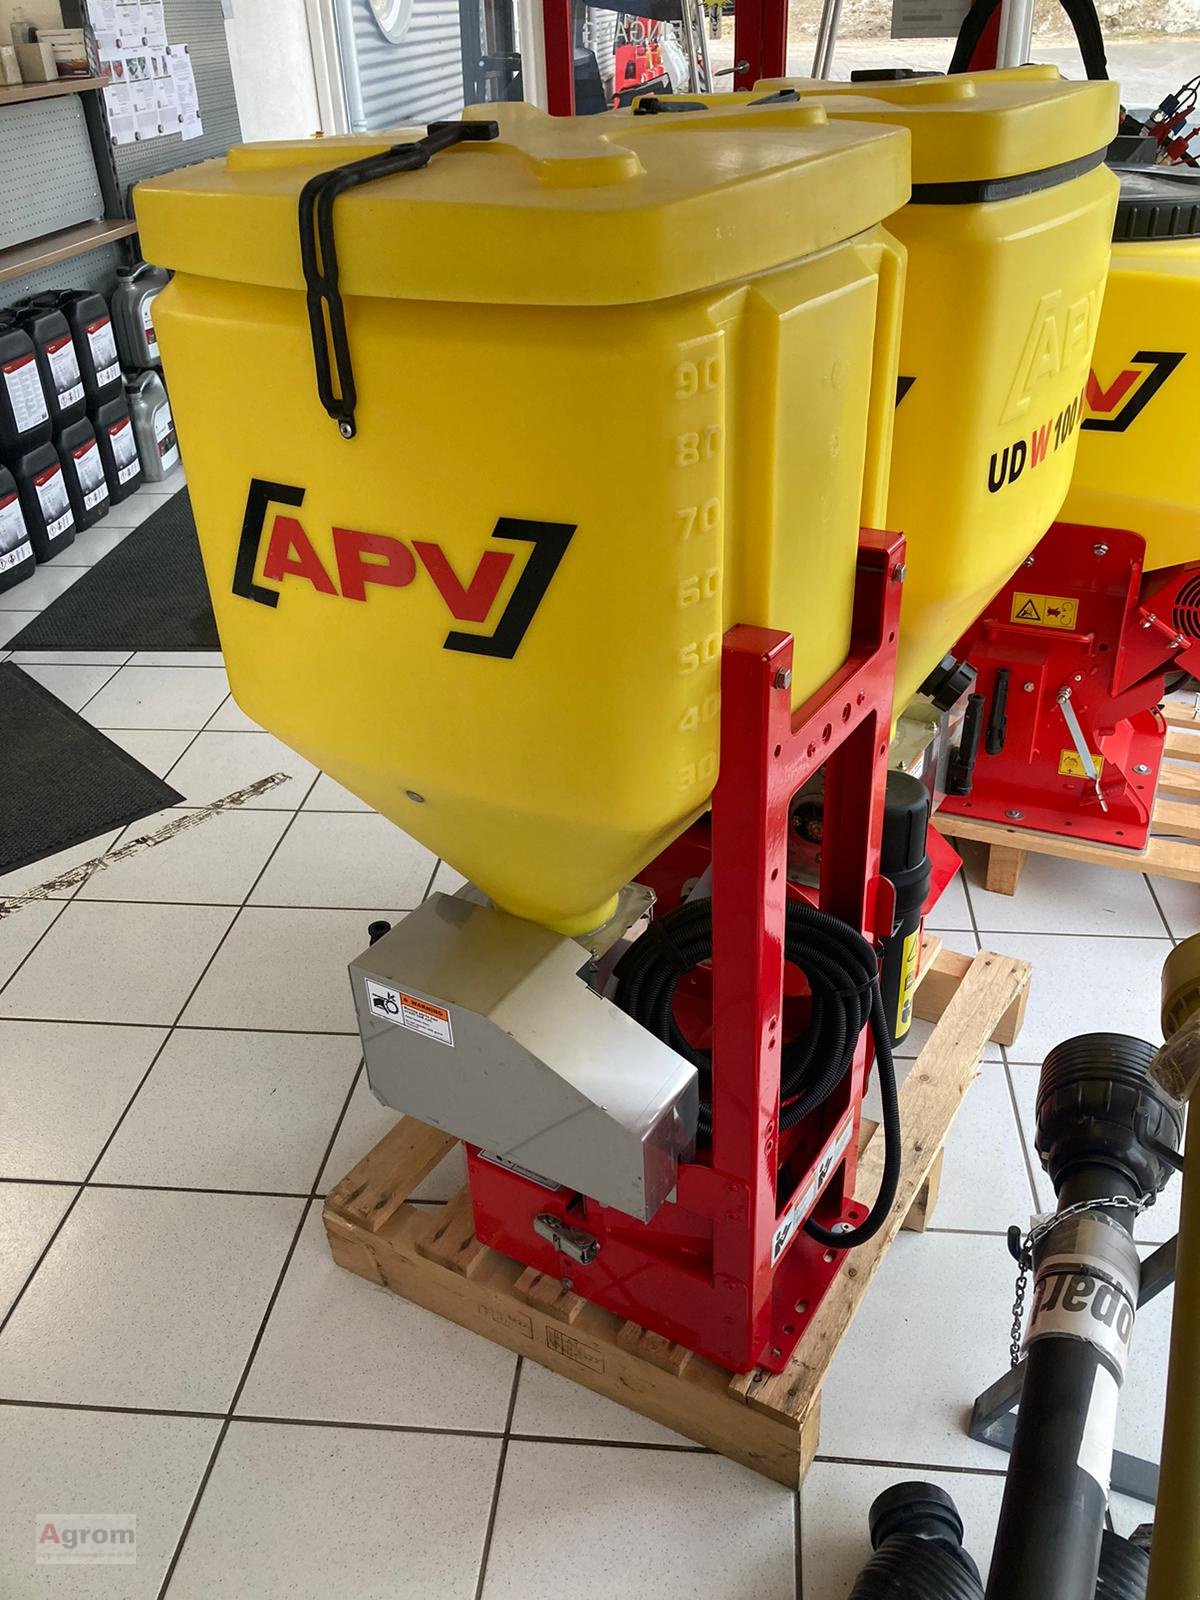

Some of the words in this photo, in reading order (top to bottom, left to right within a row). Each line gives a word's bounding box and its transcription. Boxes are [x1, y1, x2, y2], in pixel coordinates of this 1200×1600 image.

[676, 354, 720, 400] 90
[676, 424, 720, 468] 80
[676, 497, 720, 540] 70
[679, 632, 721, 676] 50
